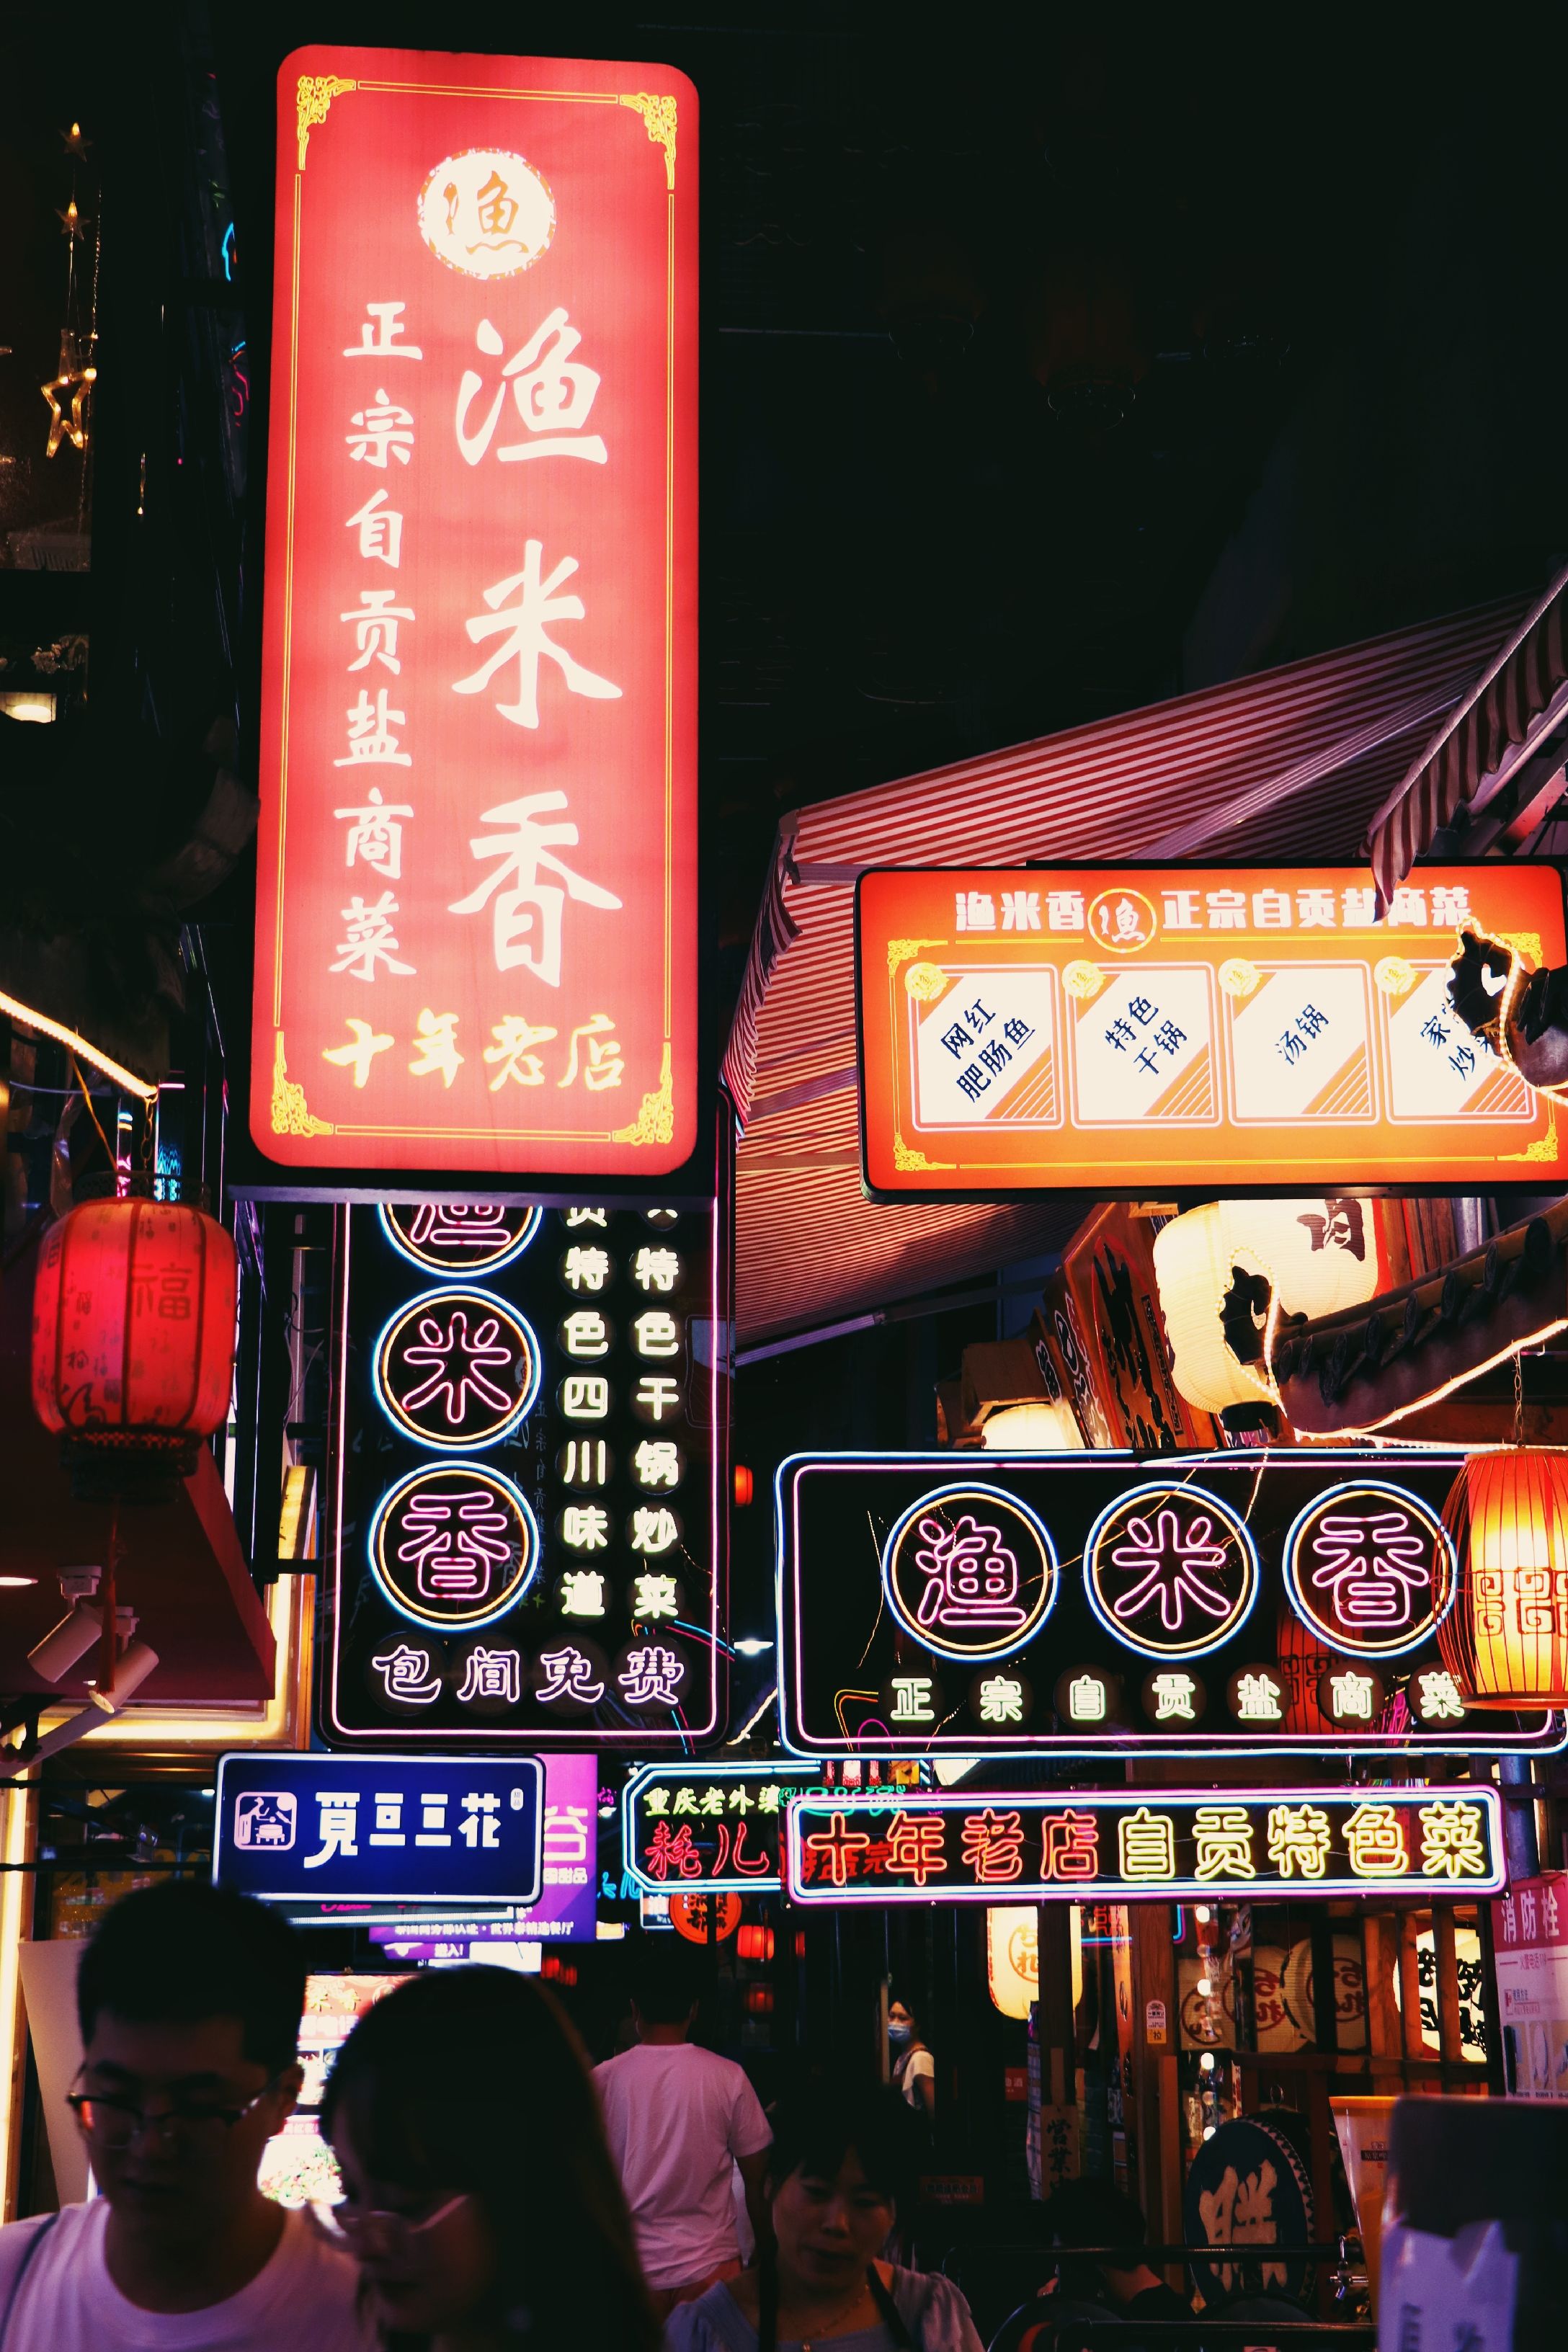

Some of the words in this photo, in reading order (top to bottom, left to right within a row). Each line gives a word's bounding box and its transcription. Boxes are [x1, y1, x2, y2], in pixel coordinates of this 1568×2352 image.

[329, 301, 424, 983] 正宗自贡盐商菜
[448, 307, 623, 988] 渔米香
[956, 891, 1085, 932] 渔米香
[1162, 886, 1472, 929] 正宗自贡盐商菜
[322, 1008, 625, 1092] 十年老店
[940, 999, 996, 1059] 网红
[1105, 997, 1159, 1051] 特色
[1133, 1020, 1187, 1074] 干锅
[1275, 1004, 1329, 1065] 汤锅
[956, 1018, 1035, 1103] 肥肠鱼
[632, 1208, 681, 1619] 特色干锅炒菜
[917, 1510, 1430, 1630] 渔米香
[373, 1645, 685, 1703] 包间免费
[890, 1671, 1465, 1721] 正宗自贡盐商菜
[808, 1801, 1486, 1885] 十年老店自贡特色菜
[1501, 1885, 1560, 1943] 消防栓
